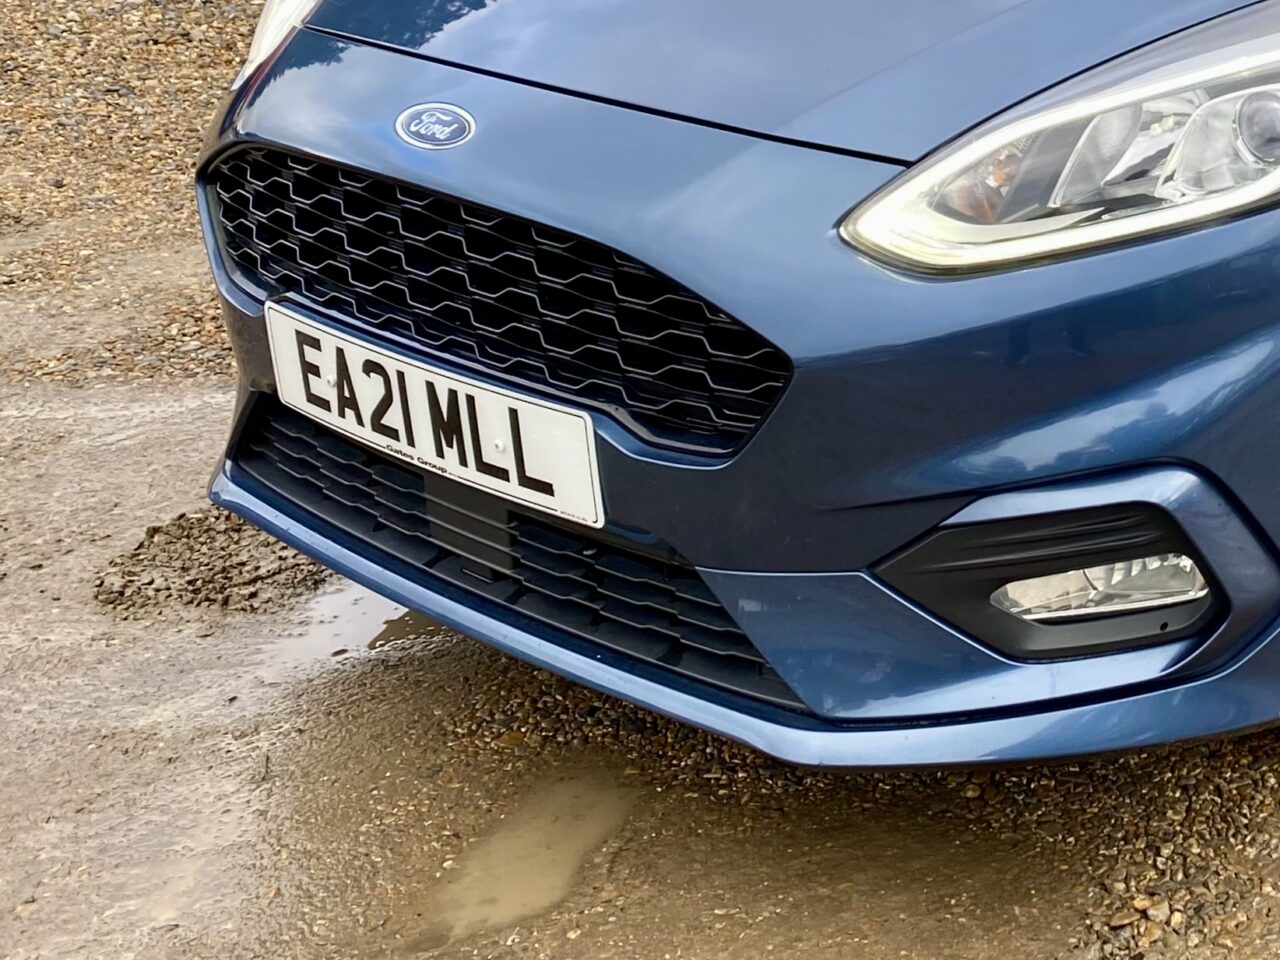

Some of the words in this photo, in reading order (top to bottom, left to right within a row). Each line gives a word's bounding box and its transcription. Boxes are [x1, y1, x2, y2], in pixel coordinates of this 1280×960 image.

[294, 328, 417, 449] EA21
[425, 379, 555, 498] MLL
[416, 456, 449, 474] Group
